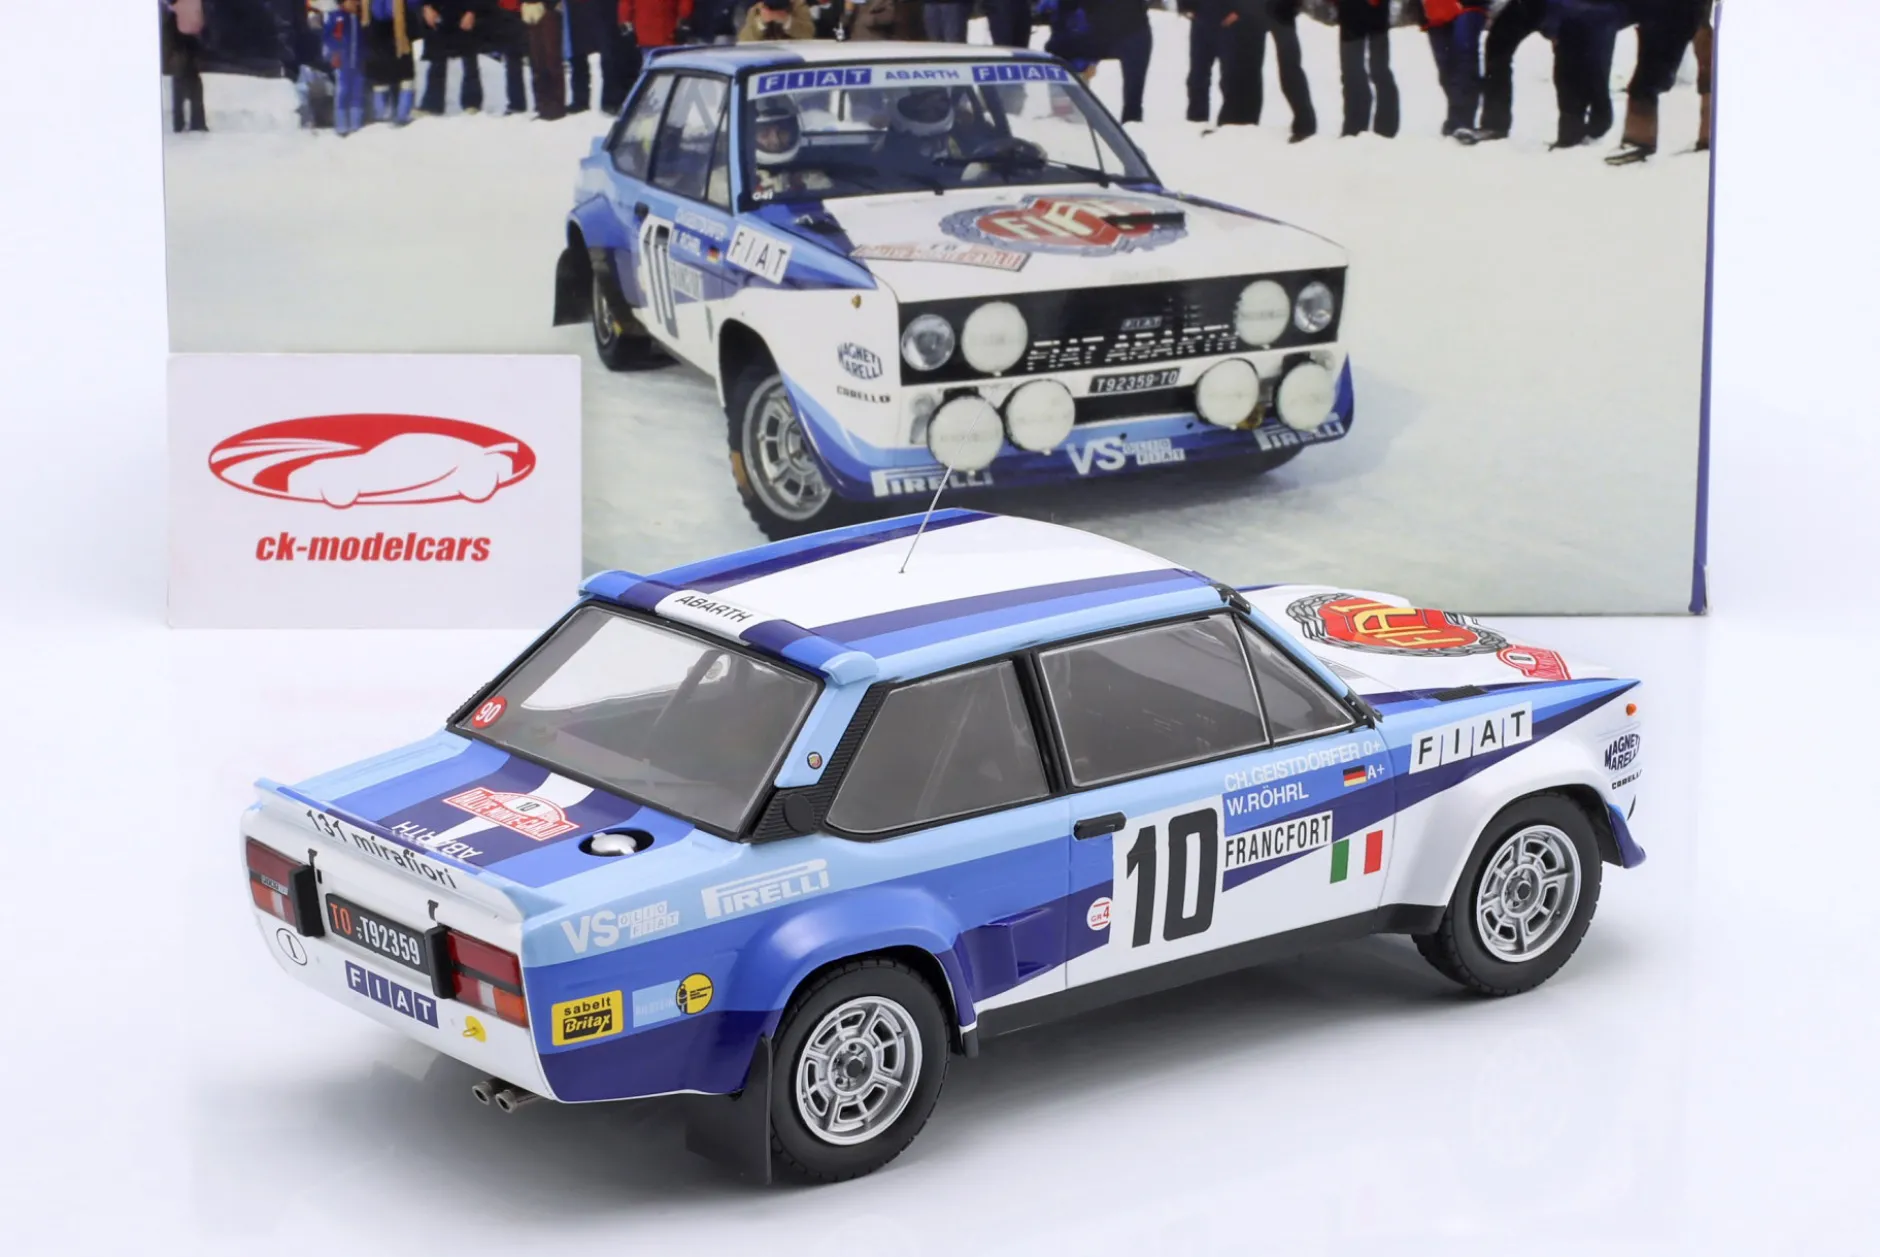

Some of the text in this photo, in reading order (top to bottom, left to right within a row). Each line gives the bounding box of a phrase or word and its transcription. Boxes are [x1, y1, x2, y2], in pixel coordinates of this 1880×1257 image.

[765, 66, 1066, 90] FIAT ABARTH FIAT
[731, 231, 787, 275] FIAT
[1066, 436, 1126, 475] VS
[870, 465, 994, 498] PIRELLI
[256, 532, 491, 562] ck-modelcars
[675, 594, 754, 623] ABARTH
[1330, 603, 1465, 646] FIAT
[475, 701, 502, 723] 90
[1418, 710, 1526, 765] FIAT
[1226, 764, 1385, 817] W.RÖHRL A+
[306, 810, 457, 889] 131 mirafiori
[391, 820, 484, 859] ABARTH
[1225, 814, 1332, 868] FRANCFORT
[701, 858, 830, 920] PIRELLI
[1126, 807, 1218, 948] 10
[560, 903, 666, 954] VS OLIO
[632, 913, 676, 938] FIAT
[1103, 905, 1110, 919] 4
[330, 903, 421, 965] TO T92359
[349, 966, 432, 1021] FIAT
[563, 996, 612, 1017] sabelt
[564, 1009, 611, 1036] Britax
